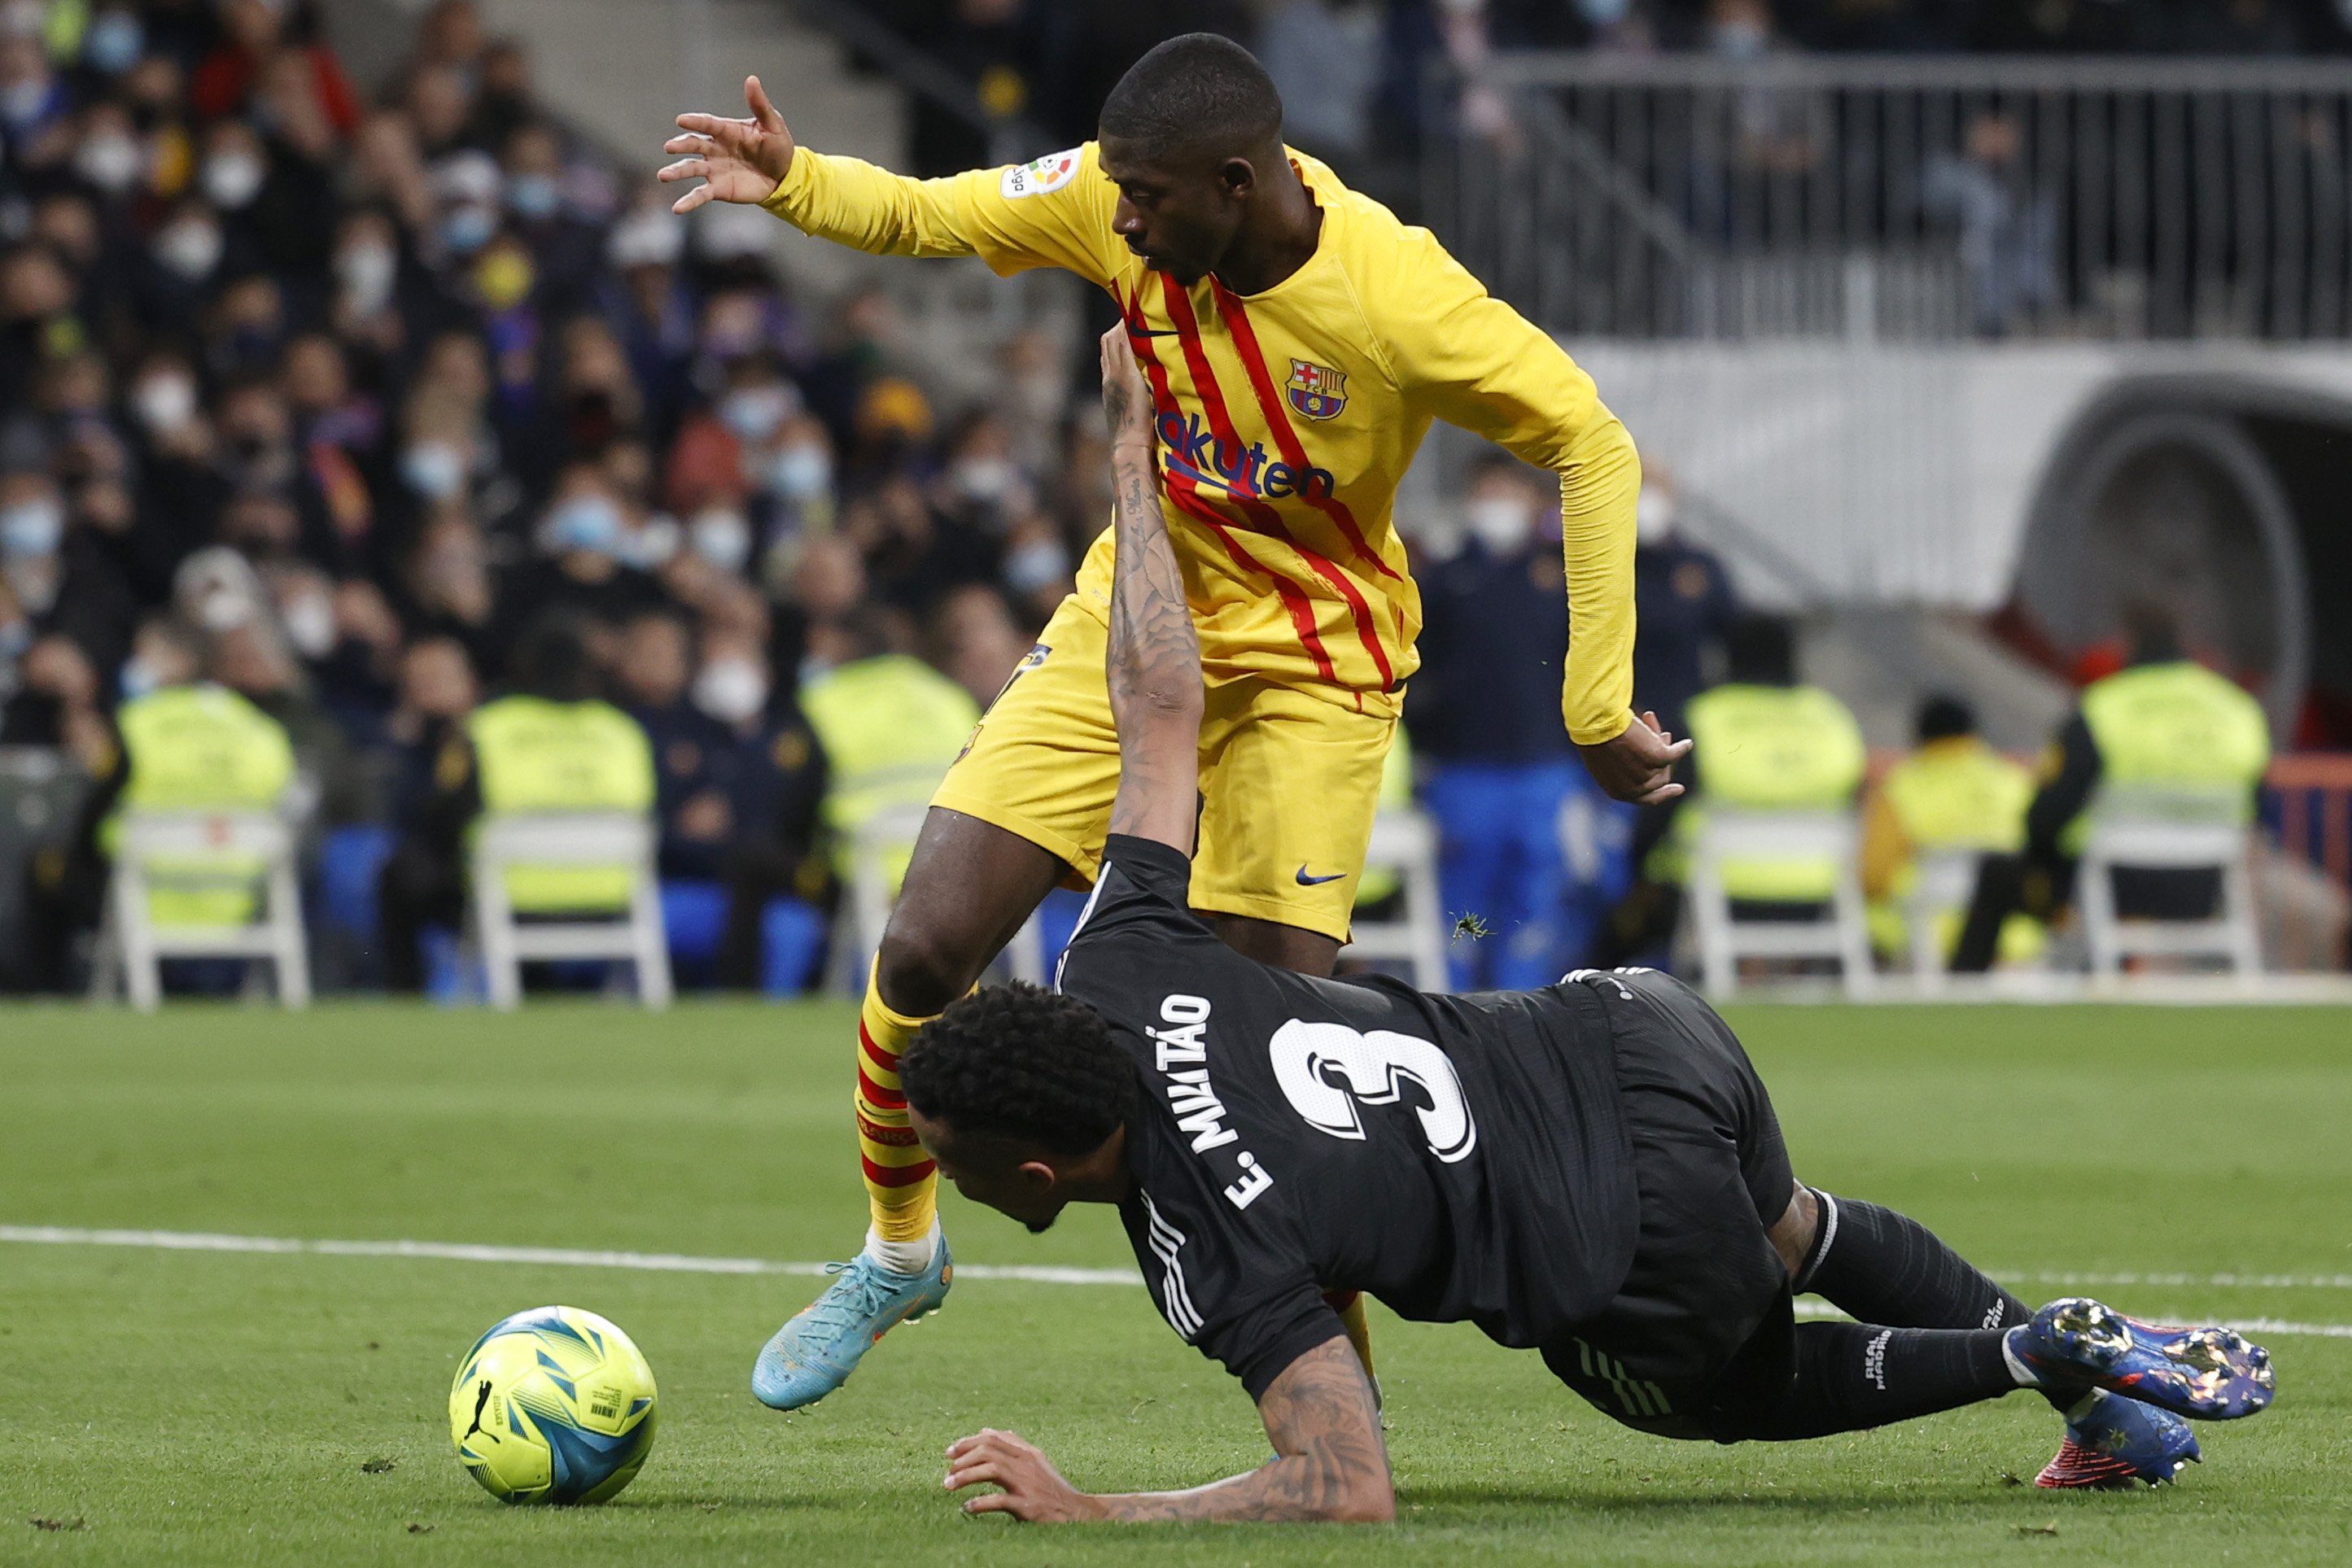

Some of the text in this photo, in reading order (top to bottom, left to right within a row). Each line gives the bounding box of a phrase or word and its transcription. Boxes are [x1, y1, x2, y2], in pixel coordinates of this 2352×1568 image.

[1152, 407, 1334, 499] akuten
[1268, 1018, 1477, 1164] 3
[1224, 1151, 1274, 1210] E.
[1989, 1297, 2004, 1330] RID
[1865, 1336, 1879, 1379] REAL
[1874, 1330, 1893, 1391] MADRID
